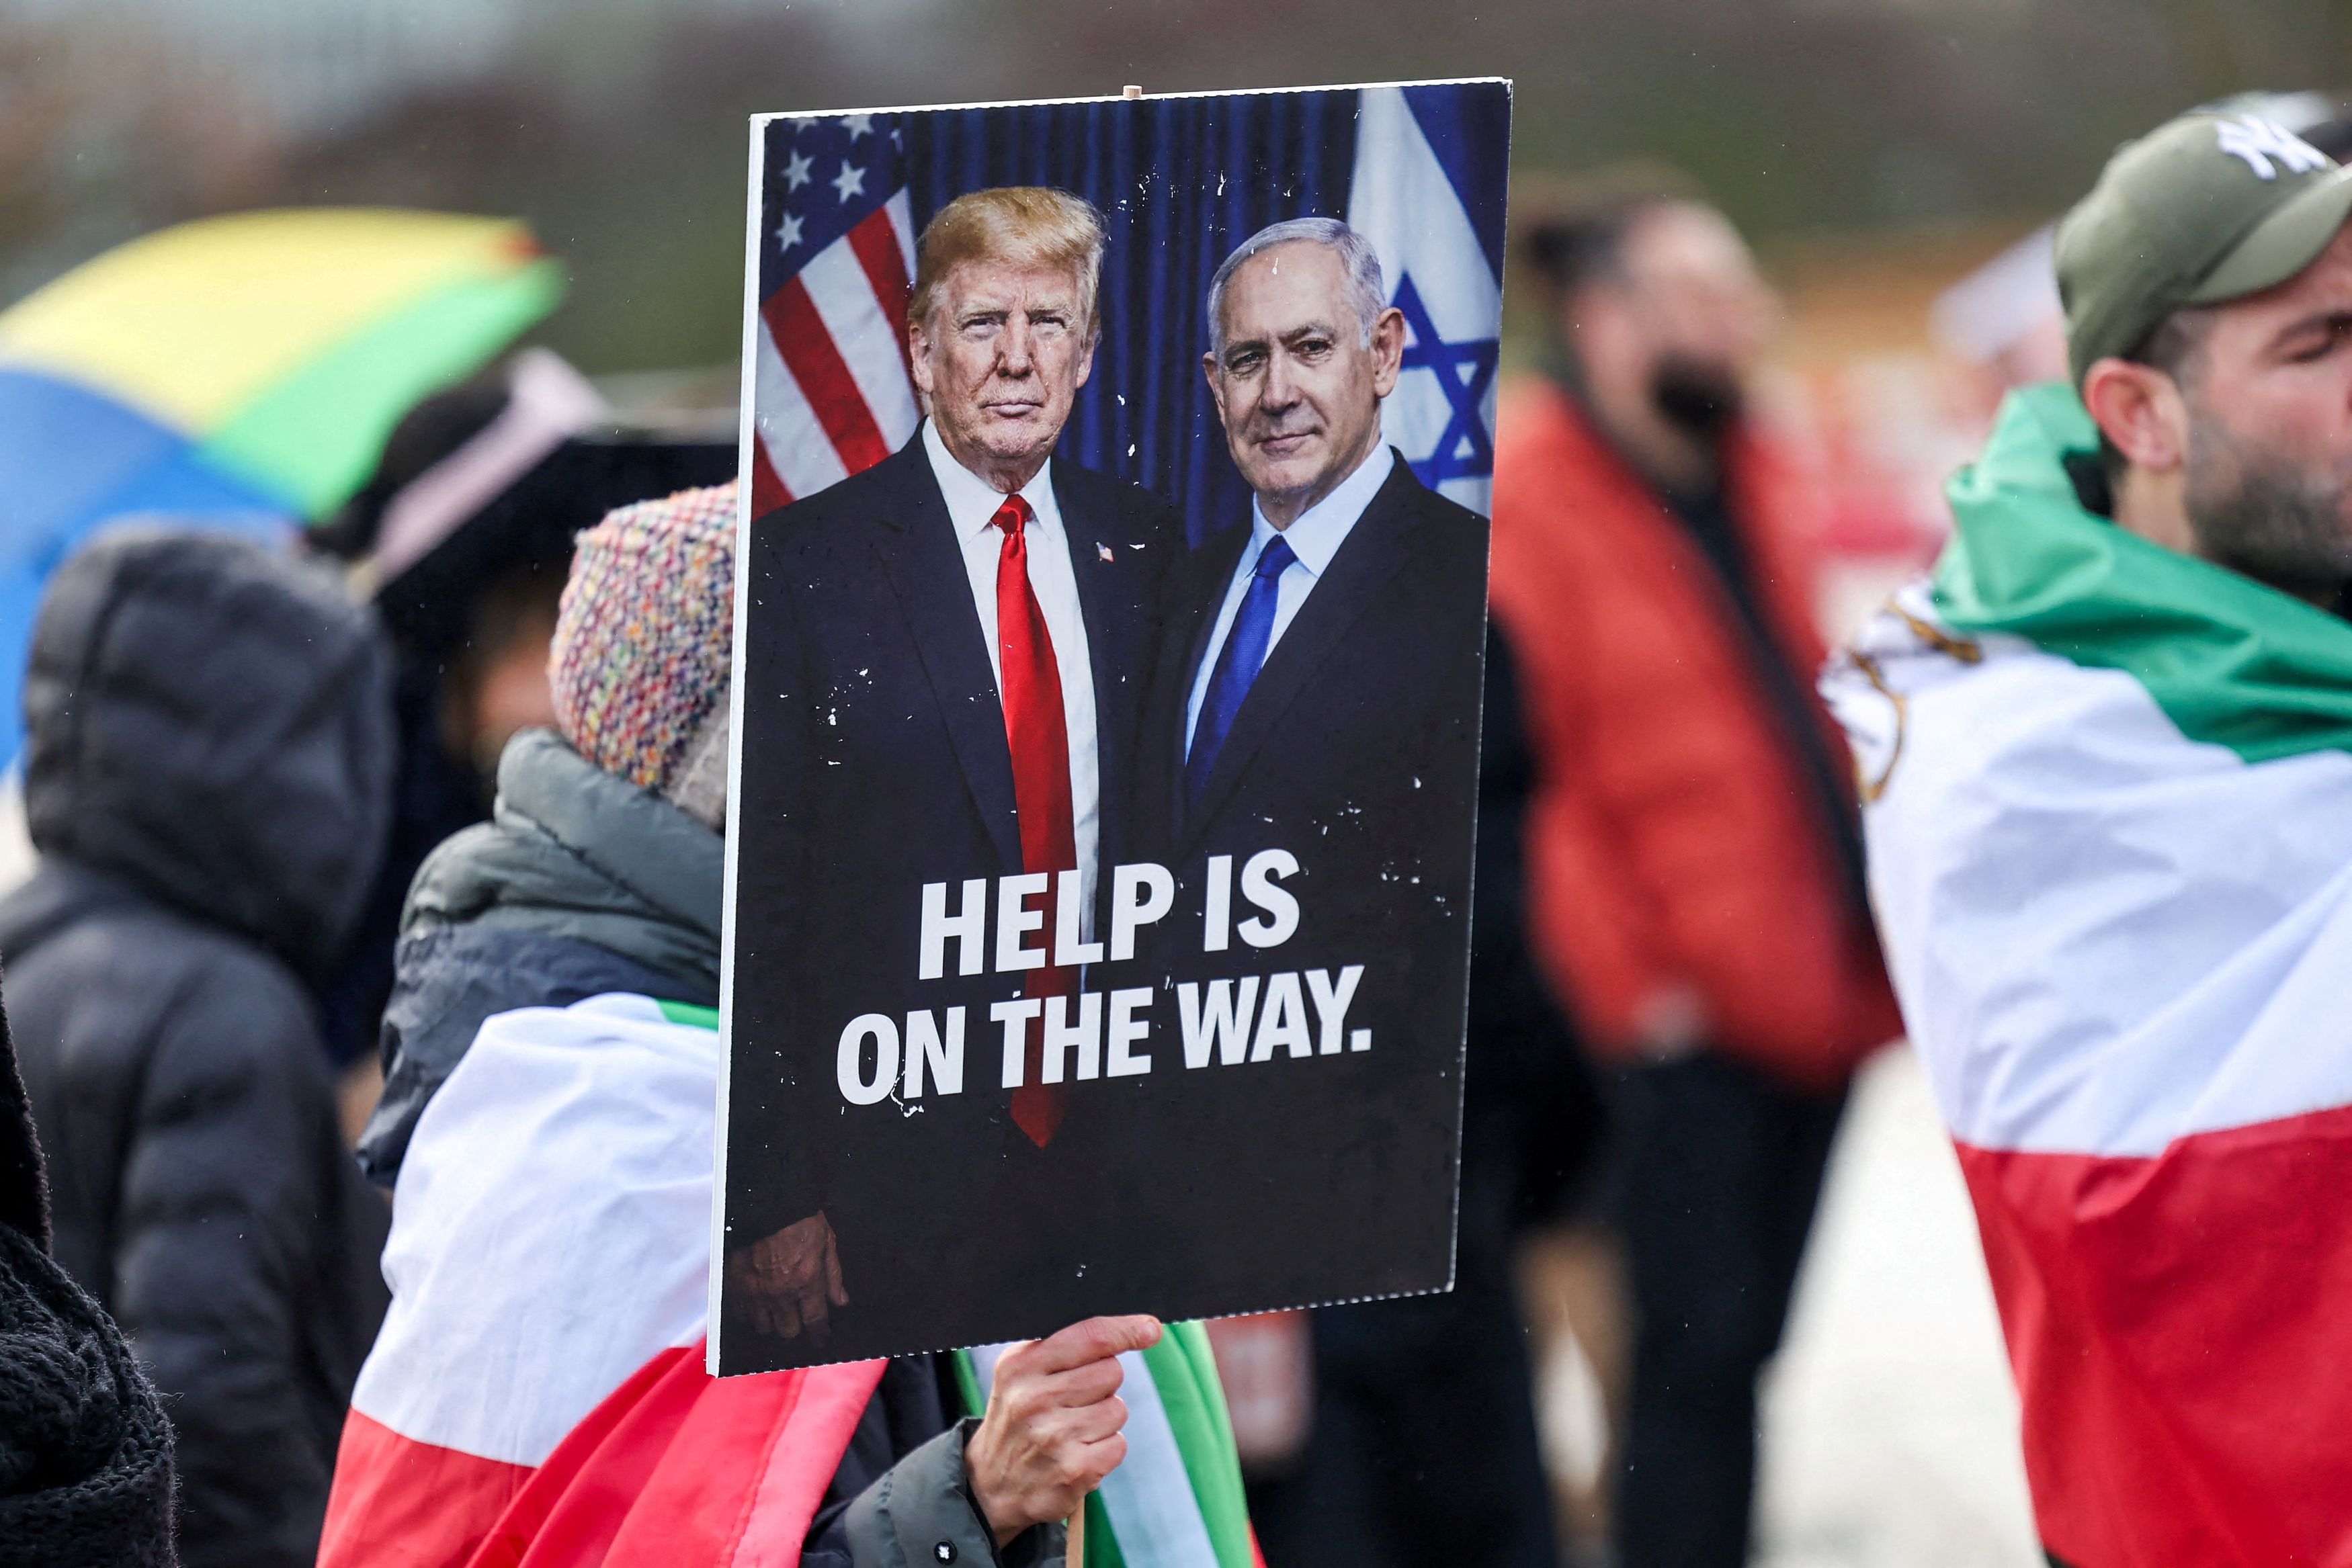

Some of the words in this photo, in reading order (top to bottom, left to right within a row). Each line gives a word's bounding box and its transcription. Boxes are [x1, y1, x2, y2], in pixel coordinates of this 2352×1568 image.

[919, 863, 1175, 980] HELP
[1204, 848, 1300, 952] IS
[837, 1006, 966, 1106] ON
[990, 987, 1154, 1089] THE
[1176, 965, 1372, 1069] WAY.
